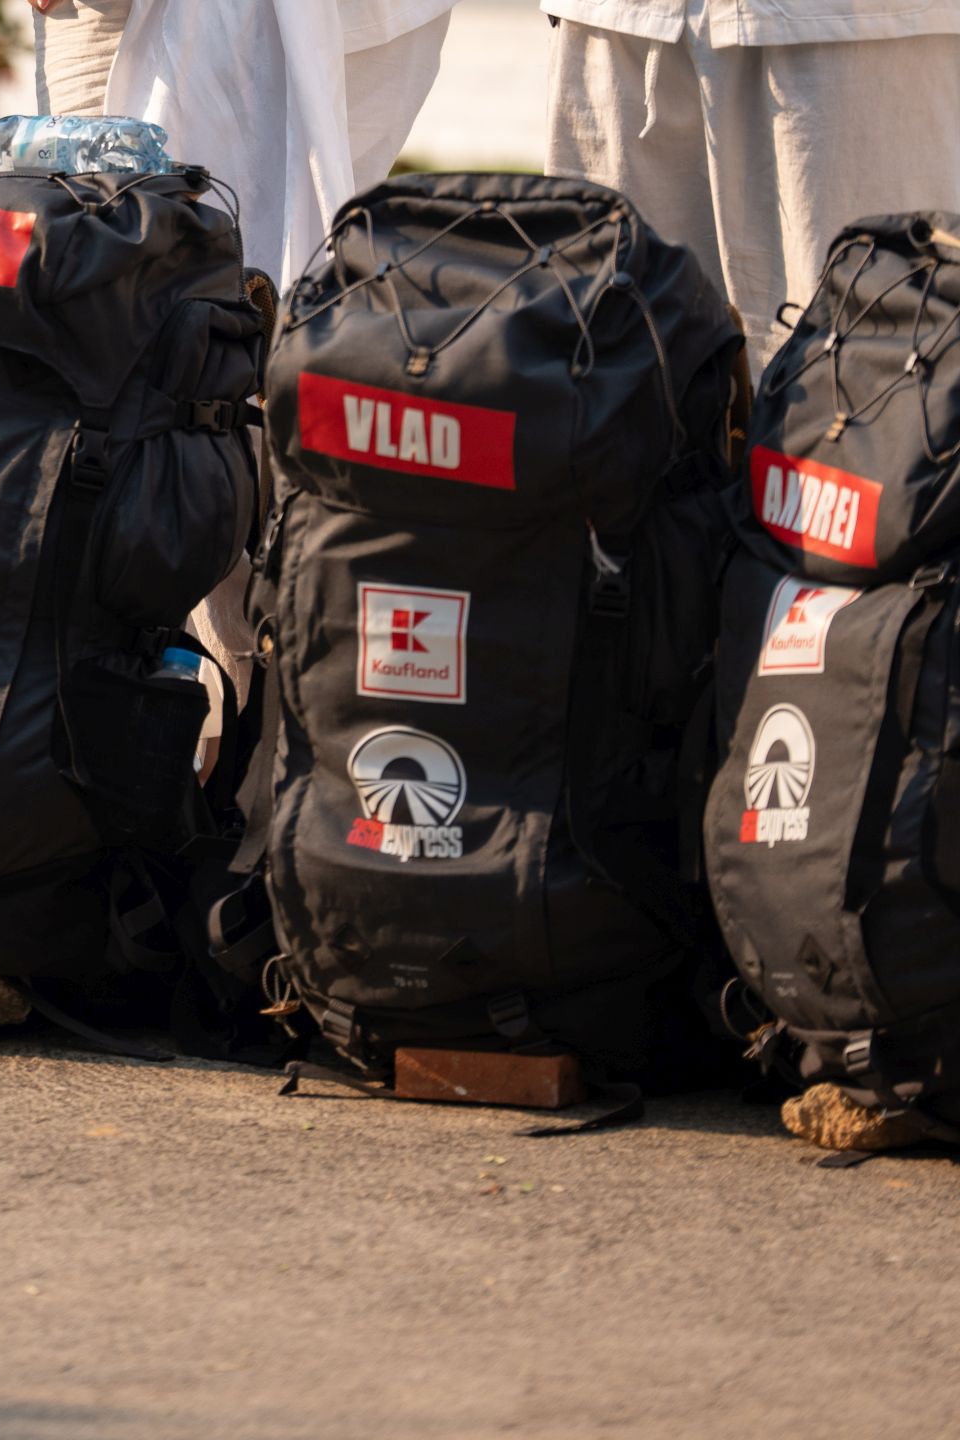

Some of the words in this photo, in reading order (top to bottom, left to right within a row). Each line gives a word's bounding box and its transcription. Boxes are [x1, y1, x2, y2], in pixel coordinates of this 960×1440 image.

[342, 393, 461, 470] VLAD
[761, 463, 861, 551] ANDREI
[769, 632, 817, 651] Kaufland
[370, 658, 450, 681] Kaufland
